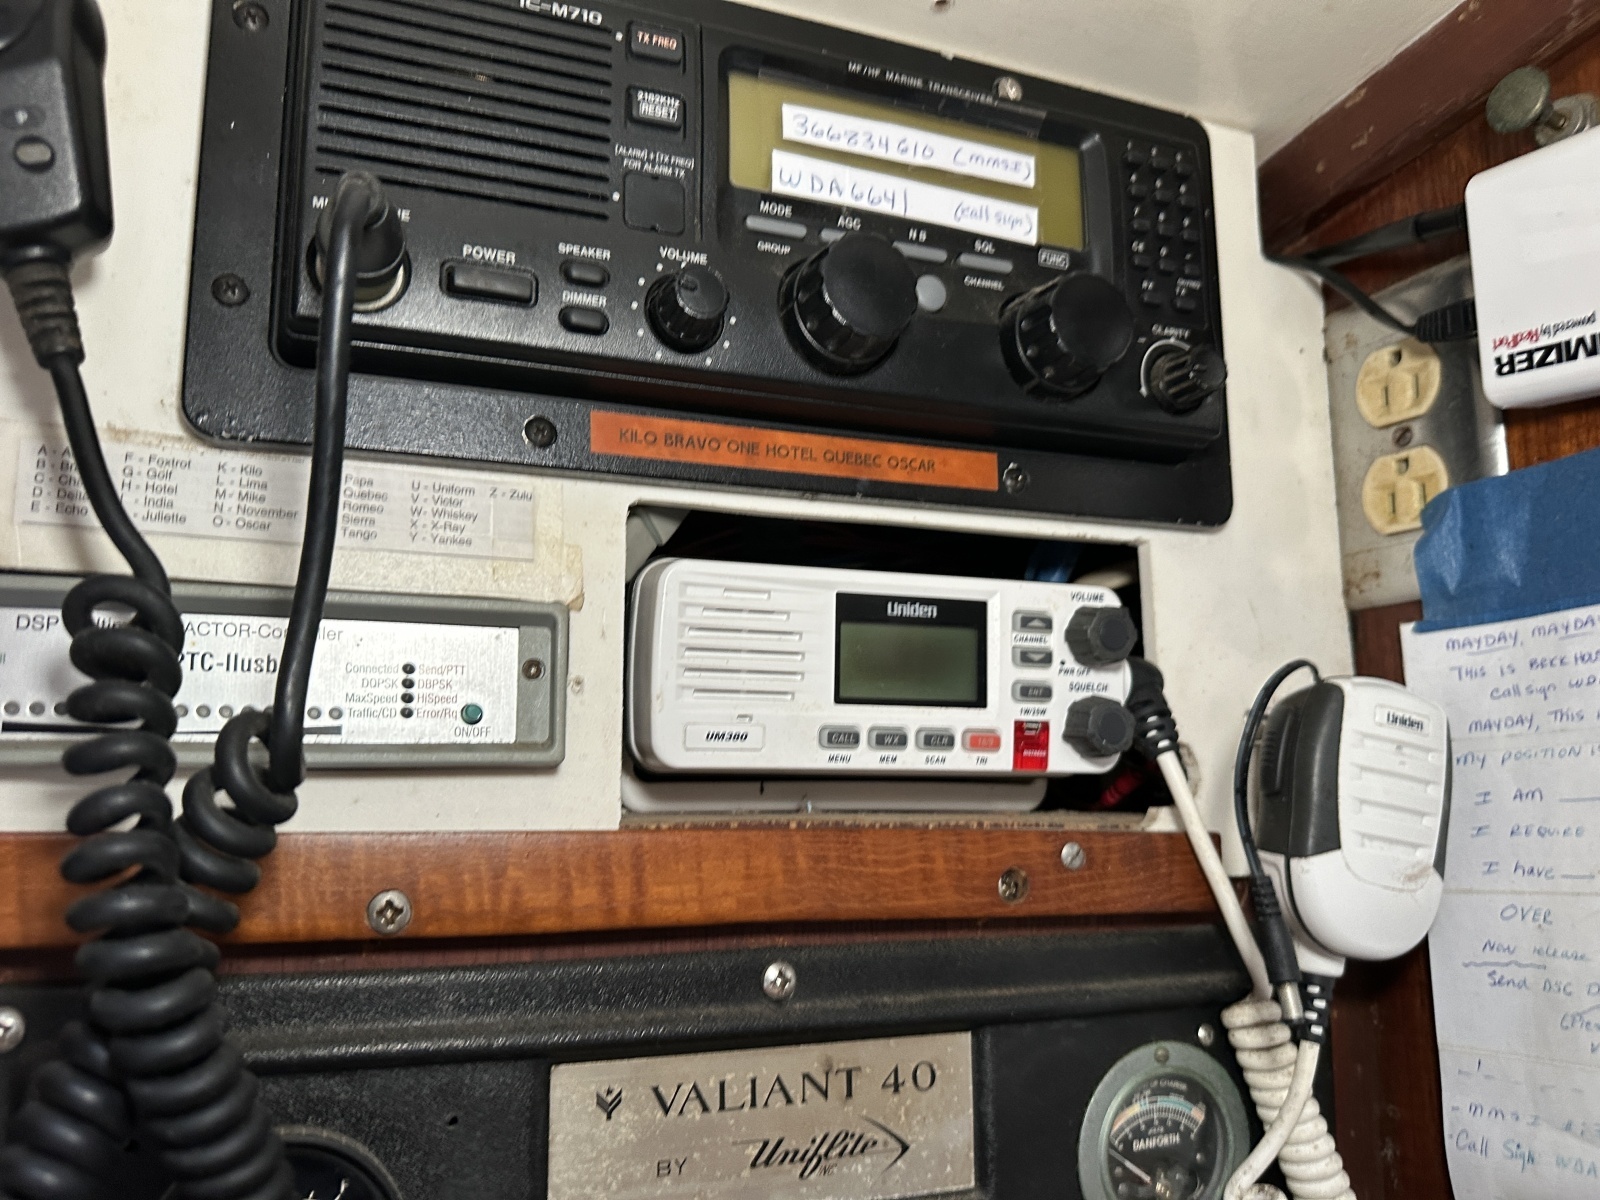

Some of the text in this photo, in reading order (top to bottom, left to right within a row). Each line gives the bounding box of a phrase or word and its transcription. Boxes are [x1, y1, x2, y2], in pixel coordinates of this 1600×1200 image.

[520, 0, 602, 26] IC-M710
[637, 31, 677, 50] TX FREQ
[885, 70, 923, 88] MARINE
[623, 158, 686, 180] FOR ALARM TX
[759, 200, 792, 218] MODE
[837, 214, 862, 231] AGC
[462, 243, 516, 265] POWER
[558, 242, 611, 261] SPEAKER
[758, 240, 790, 256] GROUP
[974, 239, 996, 255] SQL
[659, 246, 708, 266] VOLUME
[1042, 252, 1066, 268] FUNC
[964, 275, 1005, 292] CHANNEL
[562, 290, 608, 308] DIMMER
[620, 427, 936, 473] KILO BRAVO ONE HOTEL QUEBEC OSCAR
[149, 454, 192, 470] Foxtrot
[147, 467, 172, 481] Golf
[240, 464, 263, 478] Kilo
[145, 481, 178, 495] Hotel
[239, 476, 268, 490] Lima
[344, 474, 374, 488] Papa
[412, 480, 476, 496] U Uniform
[144, 494, 174, 508] India
[215, 488, 266, 504] M Mike
[343, 486, 388, 502] Quebec
[411, 492, 464, 508] V Victor
[510, 488, 532, 502] Zulu
[56, 502, 88, 516] Echo
[214, 502, 298, 520] N November
[342, 500, 384, 514] Romeo
[410, 506, 478, 524] W Whiskey
[142, 508, 186, 524] Juliette
[236, 516, 271, 530] Oscar
[342, 513, 376, 527] Sierra
[340, 526, 378, 542] Tango
[431, 533, 472, 547] Yankee
[1070, 591, 1104, 602] VOLUME
[886, 600, 938, 618] Uniden
[16, 614, 59, 631] DSP
[1531, 614, 1600, 638] MAYDA
[1014, 634, 1047, 644] CHANNEL
[345, 662, 466, 677] Connected Send/PTT
[1075, 667, 1092, 676] OFF
[418, 678, 453, 690] DBPSK
[1068, 681, 1108, 694] SQUELCH
[1568, 674, 1600, 689] WD
[345, 692, 458, 706] MaxSpeed HiSpeed
[348, 708, 398, 719] Traffic/CD
[454, 726, 492, 738] ON/OFF
[831, 732, 856, 744] CALL
[884, 734, 900, 746] WX
[828, 754, 852, 764] MENU
[879, 755, 898, 764] MEM
[924, 755, 946, 766] SCAN
[1500, 904, 1554, 926] OVER
[652, 1060, 936, 1118] VALIANT 40
[1132, 1132, 1180, 1152] DANFORTH
[656, 1159, 686, 1178] BY
